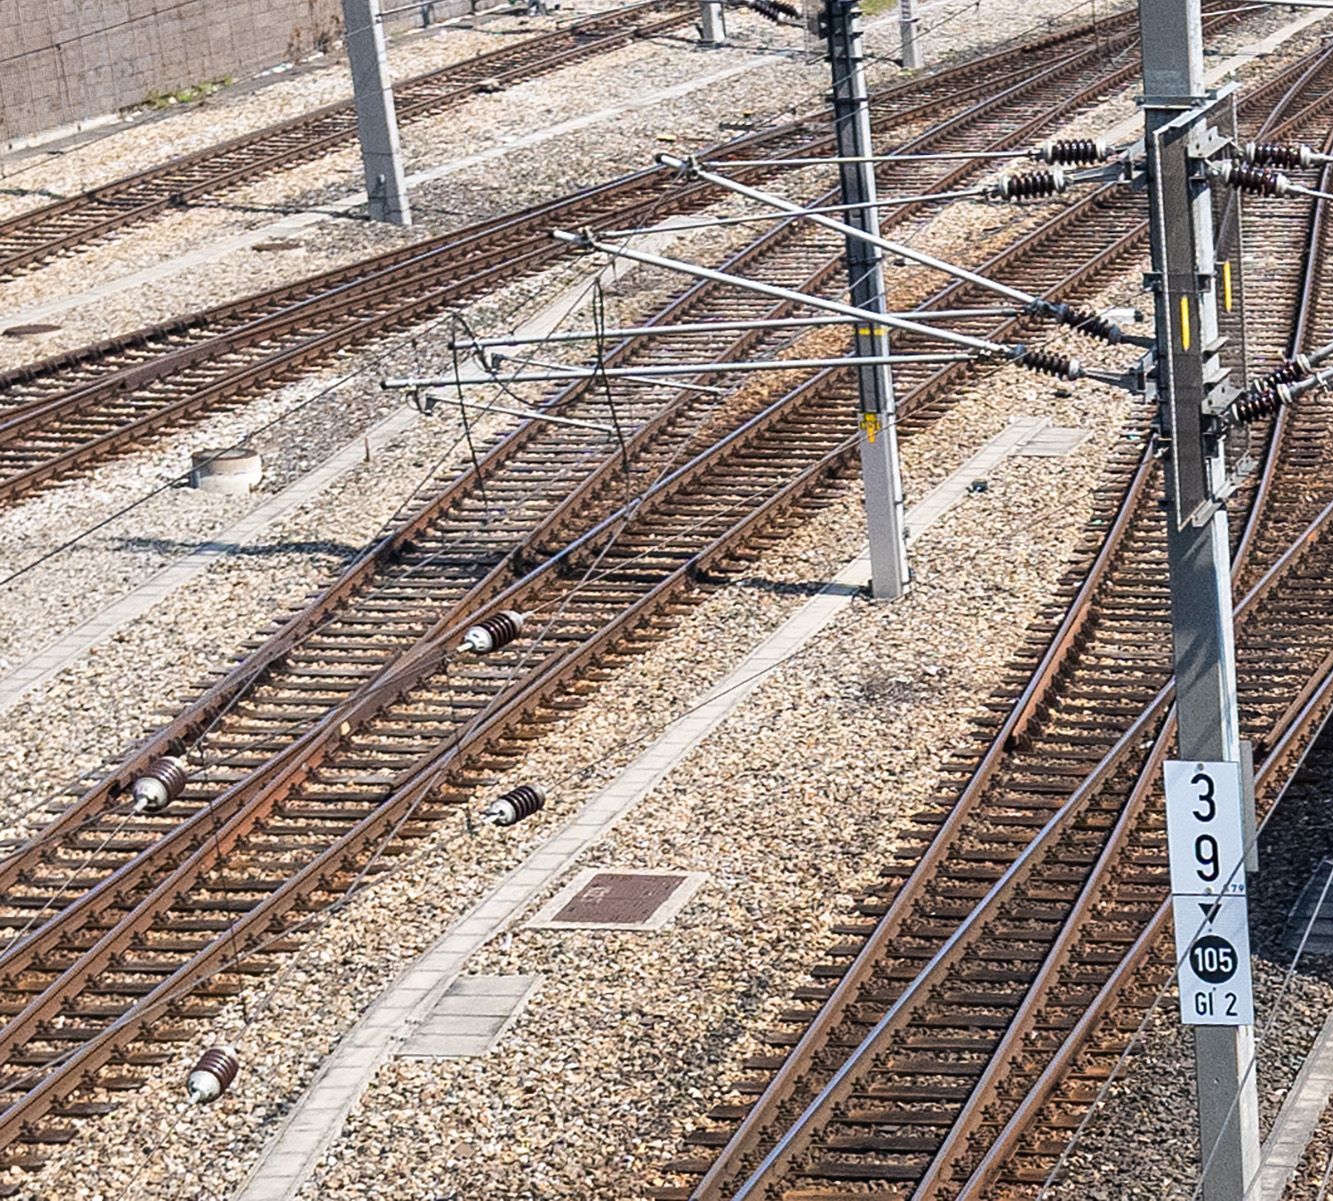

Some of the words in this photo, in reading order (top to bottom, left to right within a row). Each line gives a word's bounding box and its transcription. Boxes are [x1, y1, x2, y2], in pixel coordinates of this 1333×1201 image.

[1190, 772, 1216, 822] 3
[1195, 833, 1220, 882] 9
[1194, 946, 1233, 973] 105
[1225, 992, 1238, 1017] 2
